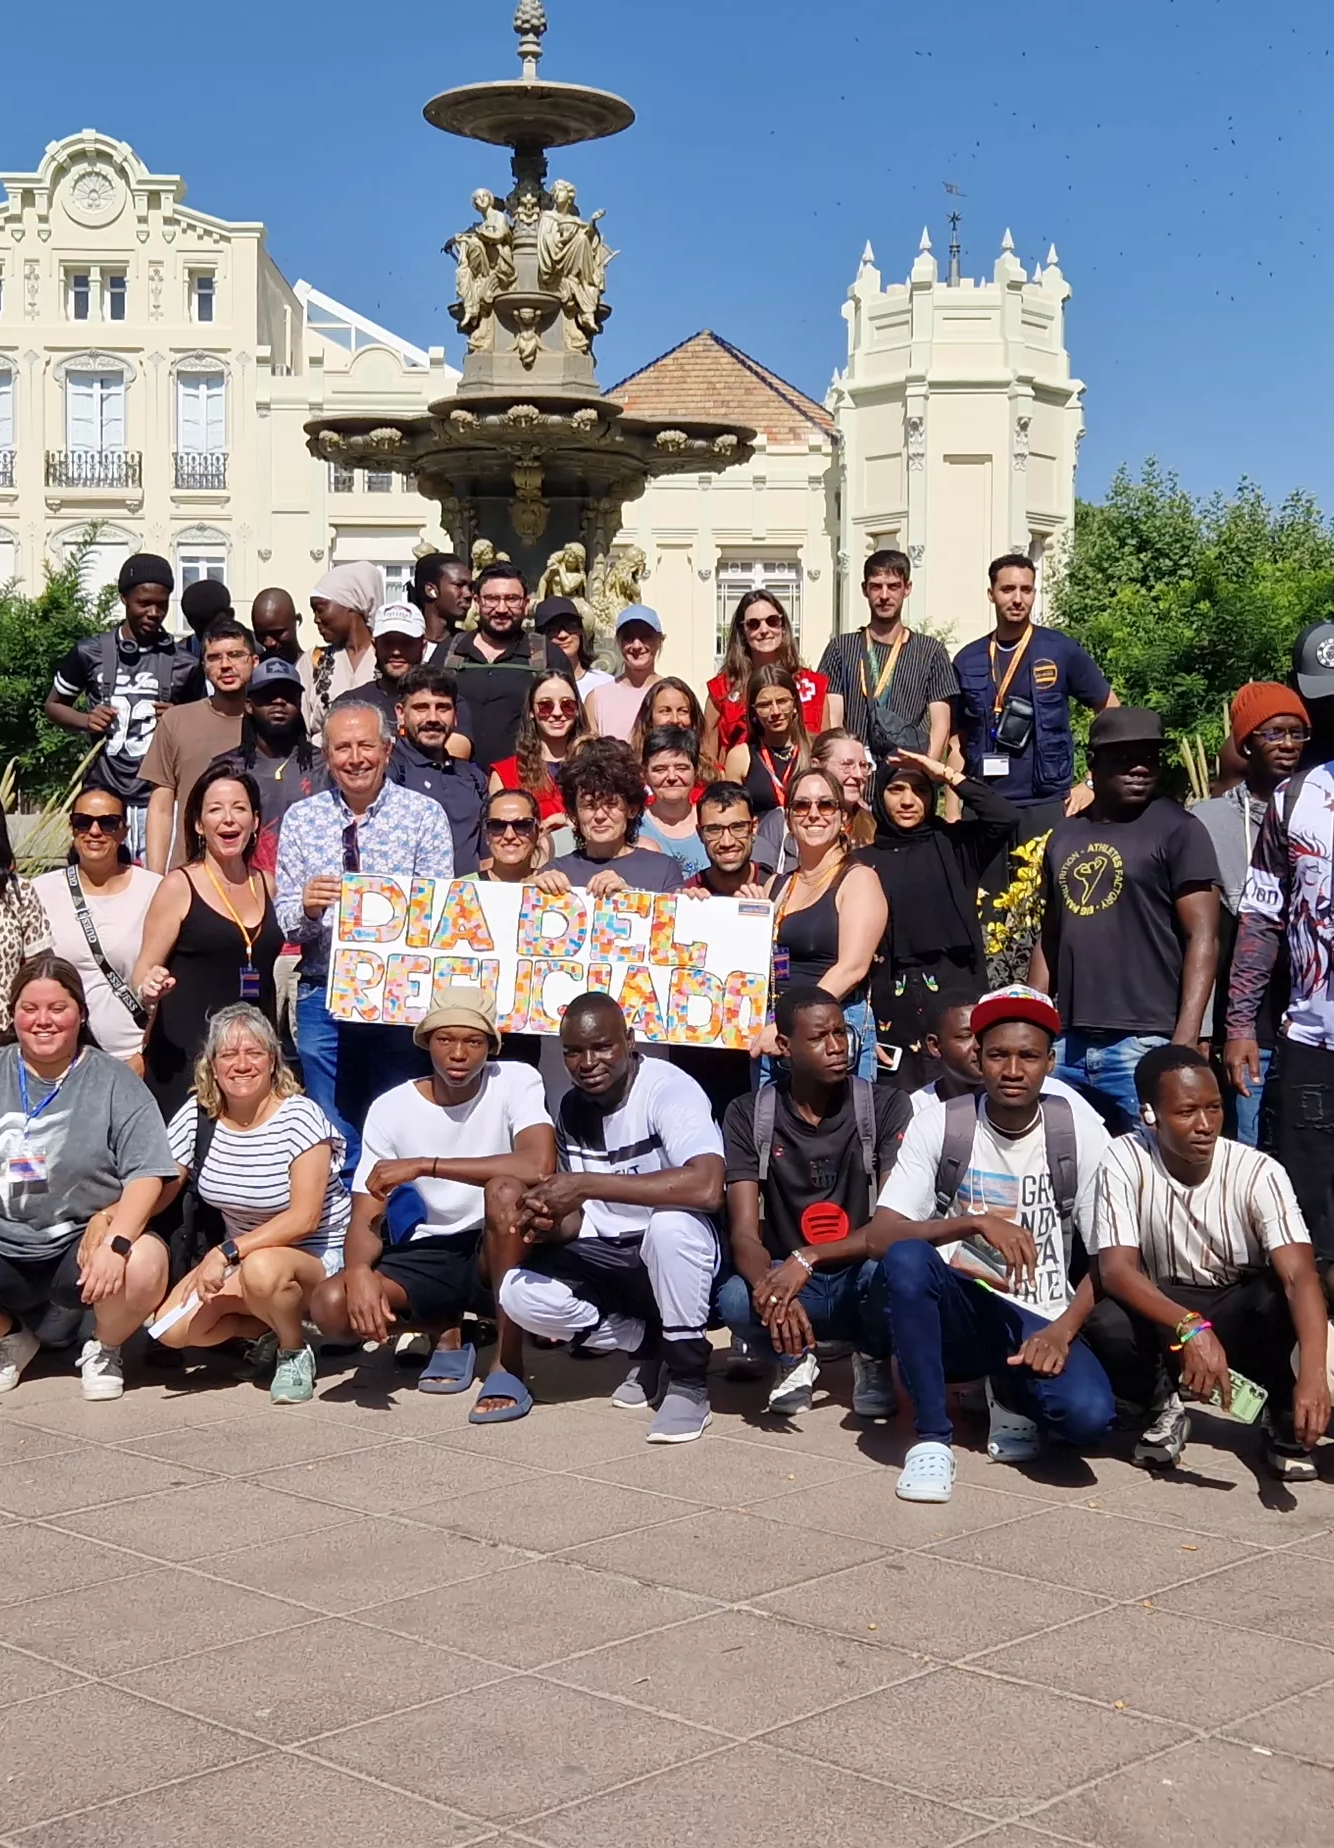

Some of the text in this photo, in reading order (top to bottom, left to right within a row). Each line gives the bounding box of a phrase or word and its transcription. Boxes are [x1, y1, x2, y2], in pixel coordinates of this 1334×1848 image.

[1087, 843, 1124, 909] ATHLETES FACTORY
[338, 874, 708, 968] DIA DEL
